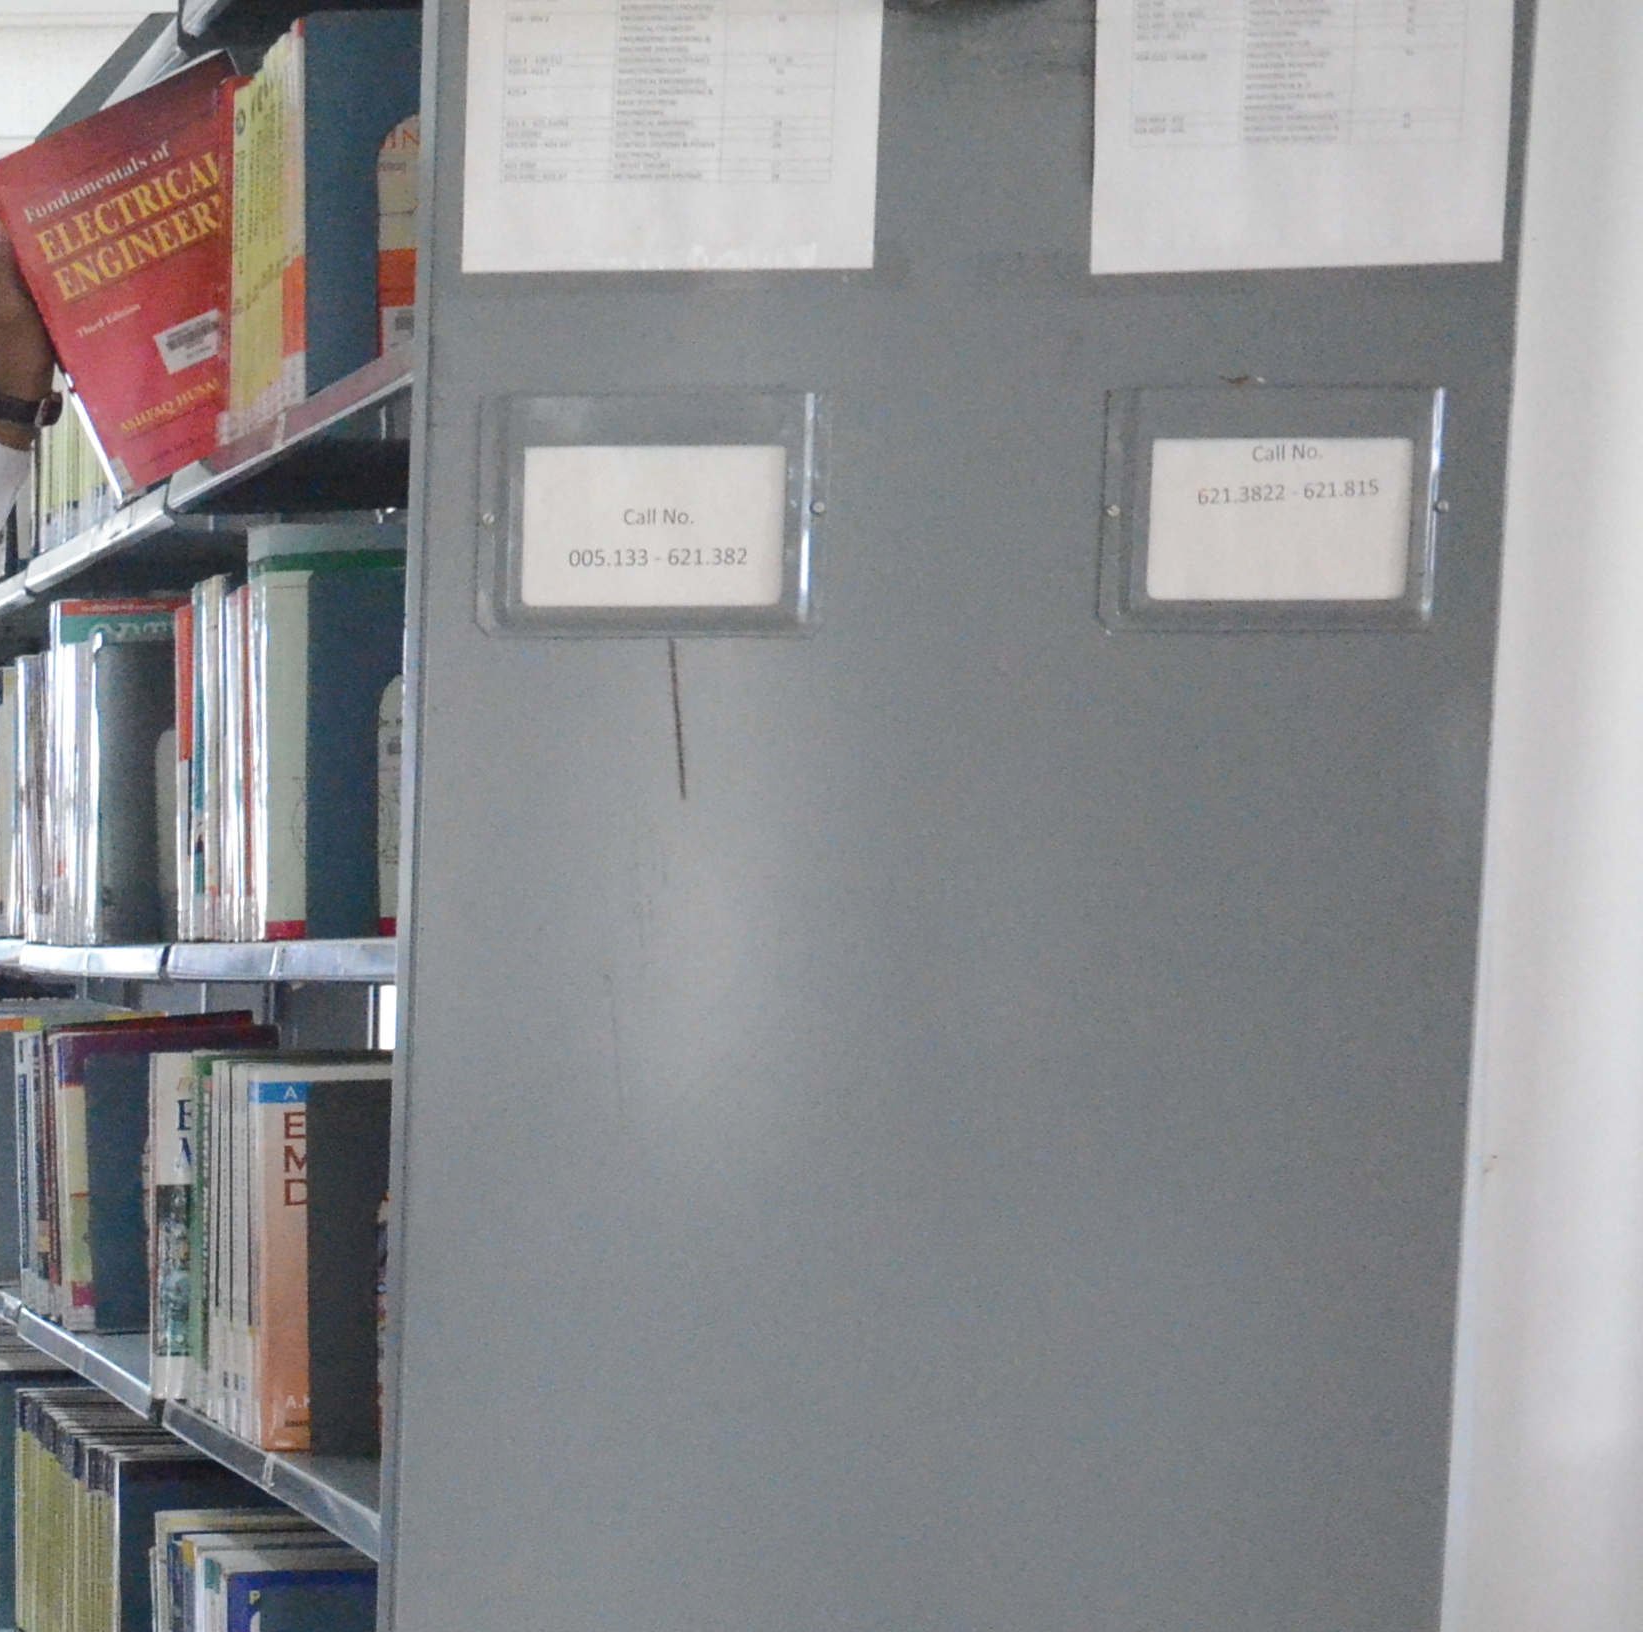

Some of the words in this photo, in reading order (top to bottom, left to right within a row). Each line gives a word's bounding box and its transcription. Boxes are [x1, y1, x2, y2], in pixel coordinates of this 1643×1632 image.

[23, 156, 148, 223] Fundamentals
[151, 140, 170, 163] of
[1252, 444, 1285, 463] Call
[1292, 444, 1323, 460] No.
[1197, 484, 1285, 505] 621.3822
[1303, 479, 1380, 500] 621.815
[623, 508, 655, 526] Call
[663, 508, 694, 525] No.
[568, 549, 648, 567] 005.133
[667, 547, 748, 566] 621.382
[284, 1086, 298, 1100] A
